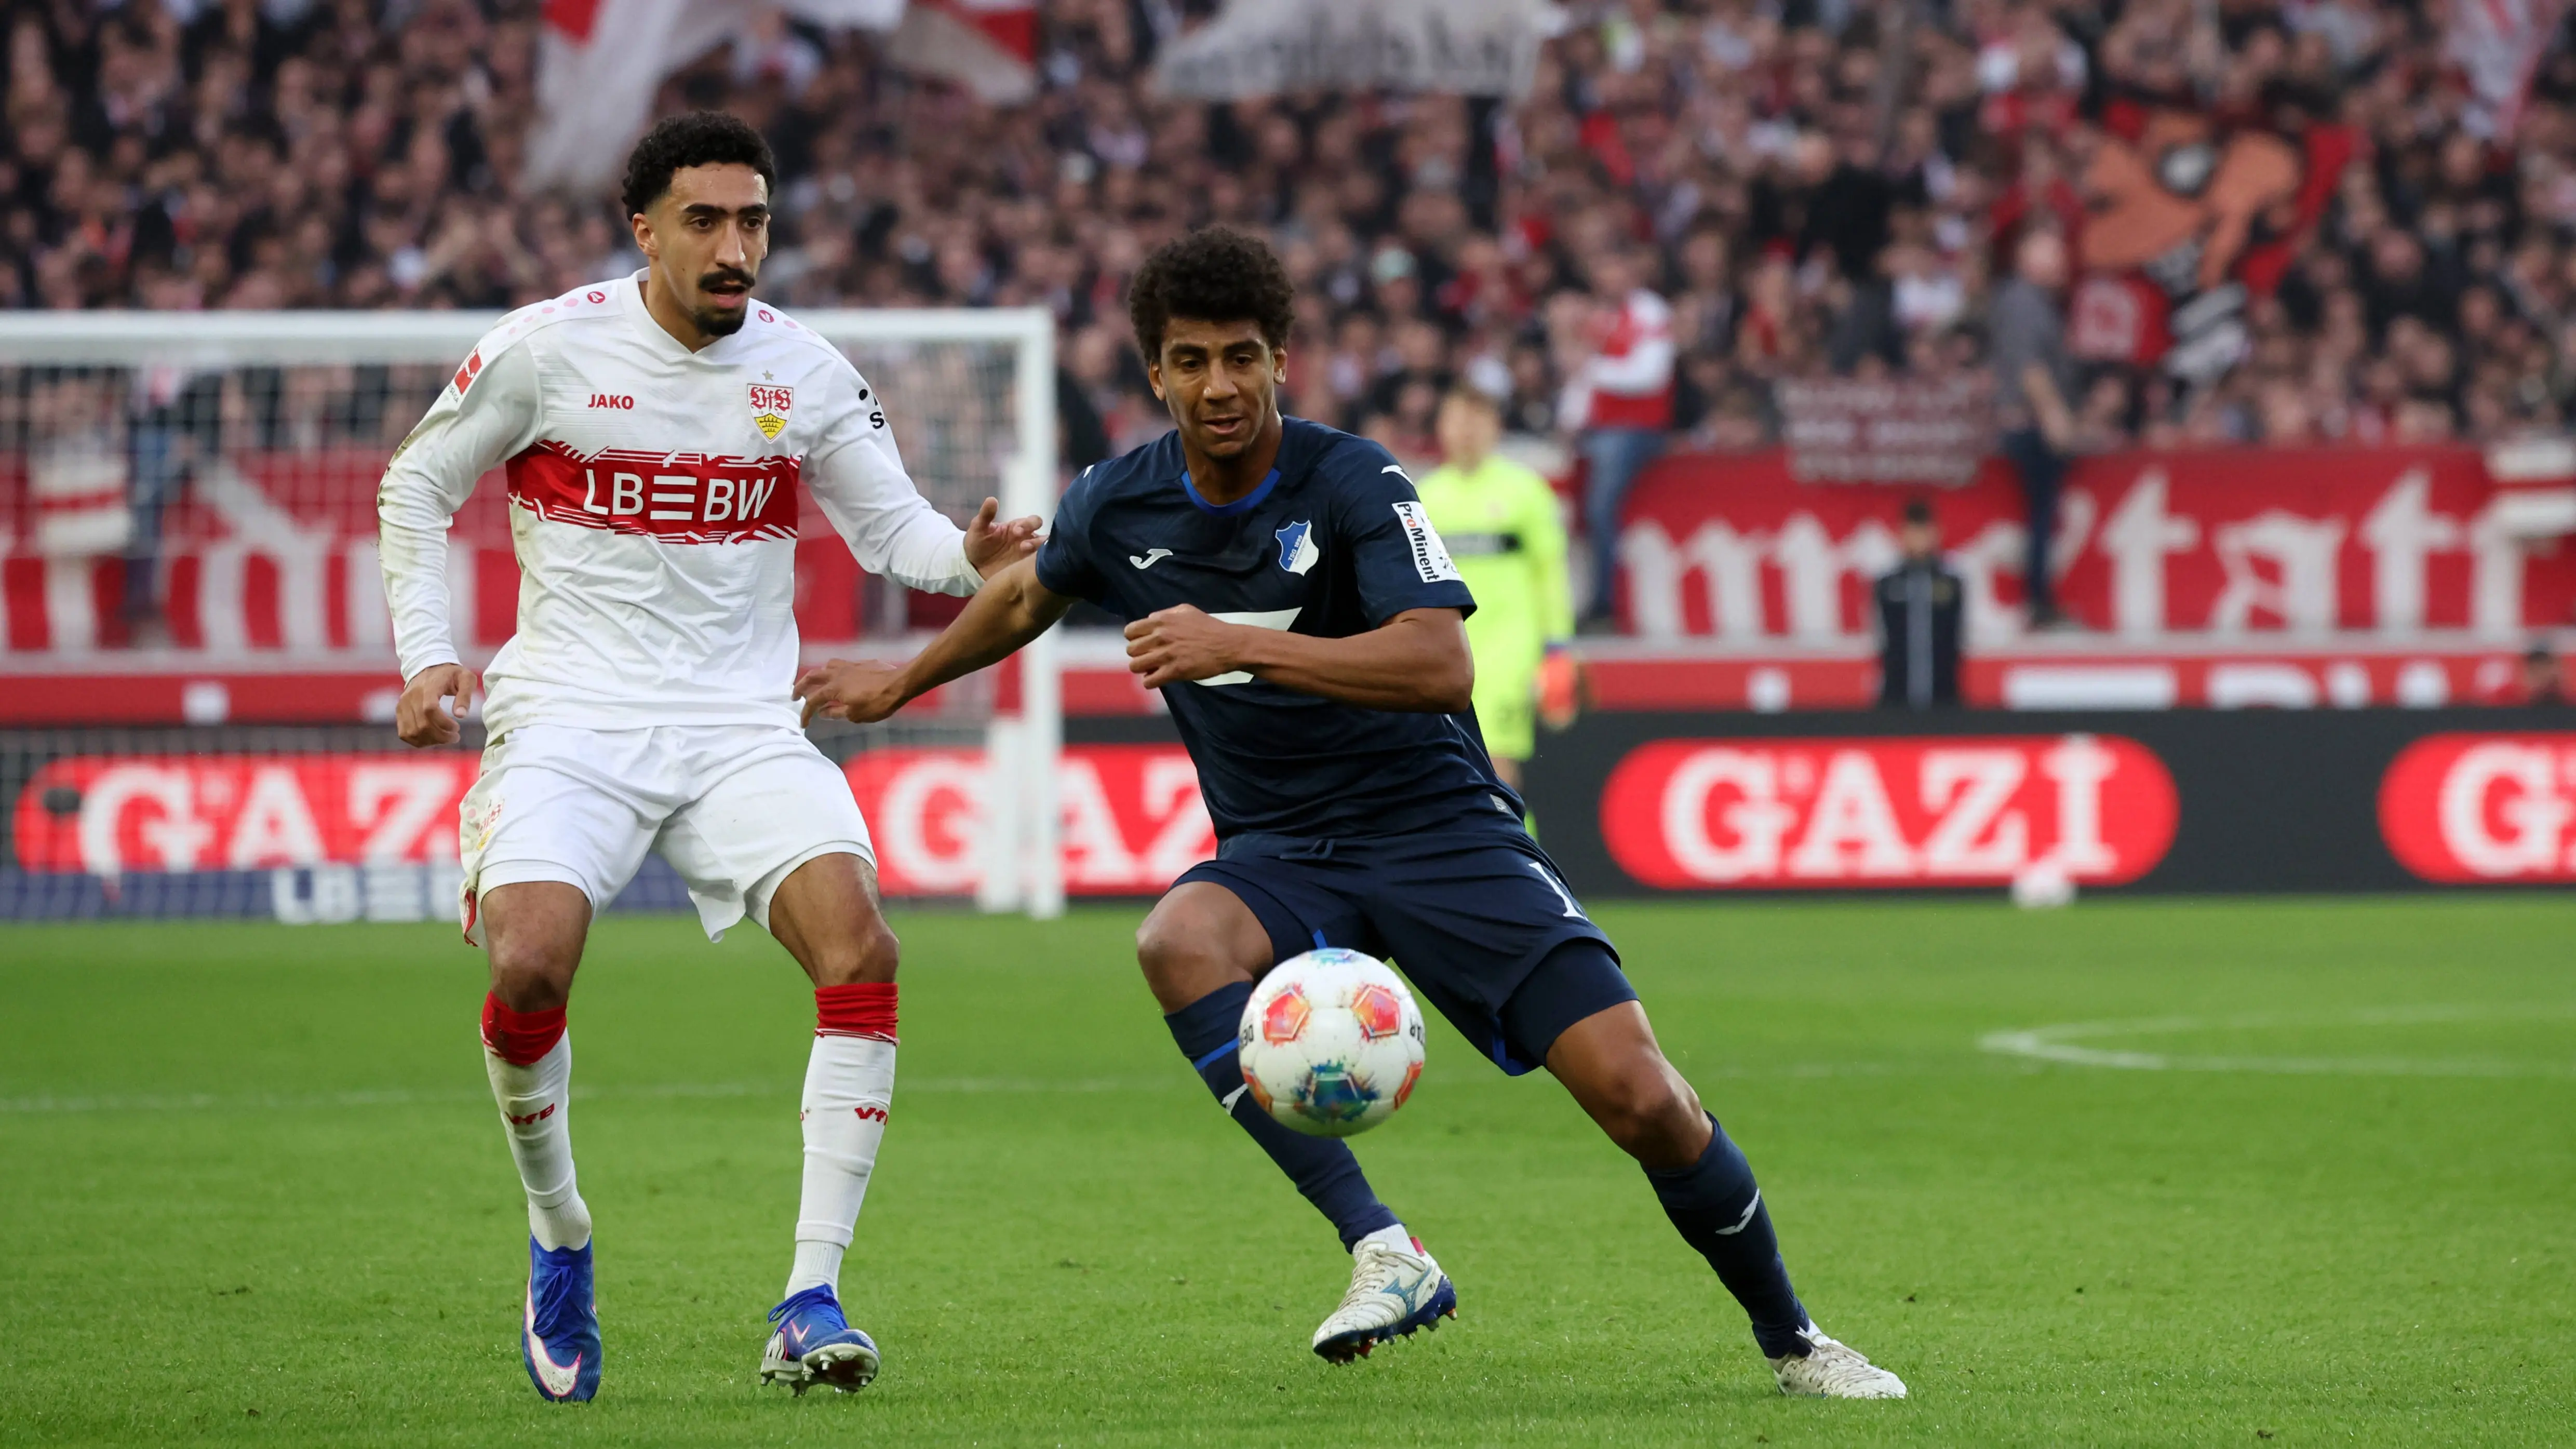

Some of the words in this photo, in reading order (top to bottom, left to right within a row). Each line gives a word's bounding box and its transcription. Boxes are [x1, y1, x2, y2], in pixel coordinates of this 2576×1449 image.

[587, 394, 634, 410] JAKO
[1288, 549, 1297, 561] TSG
[1397, 503, 1440, 581] ProMinent
[77, 762, 463, 878] GAZ
